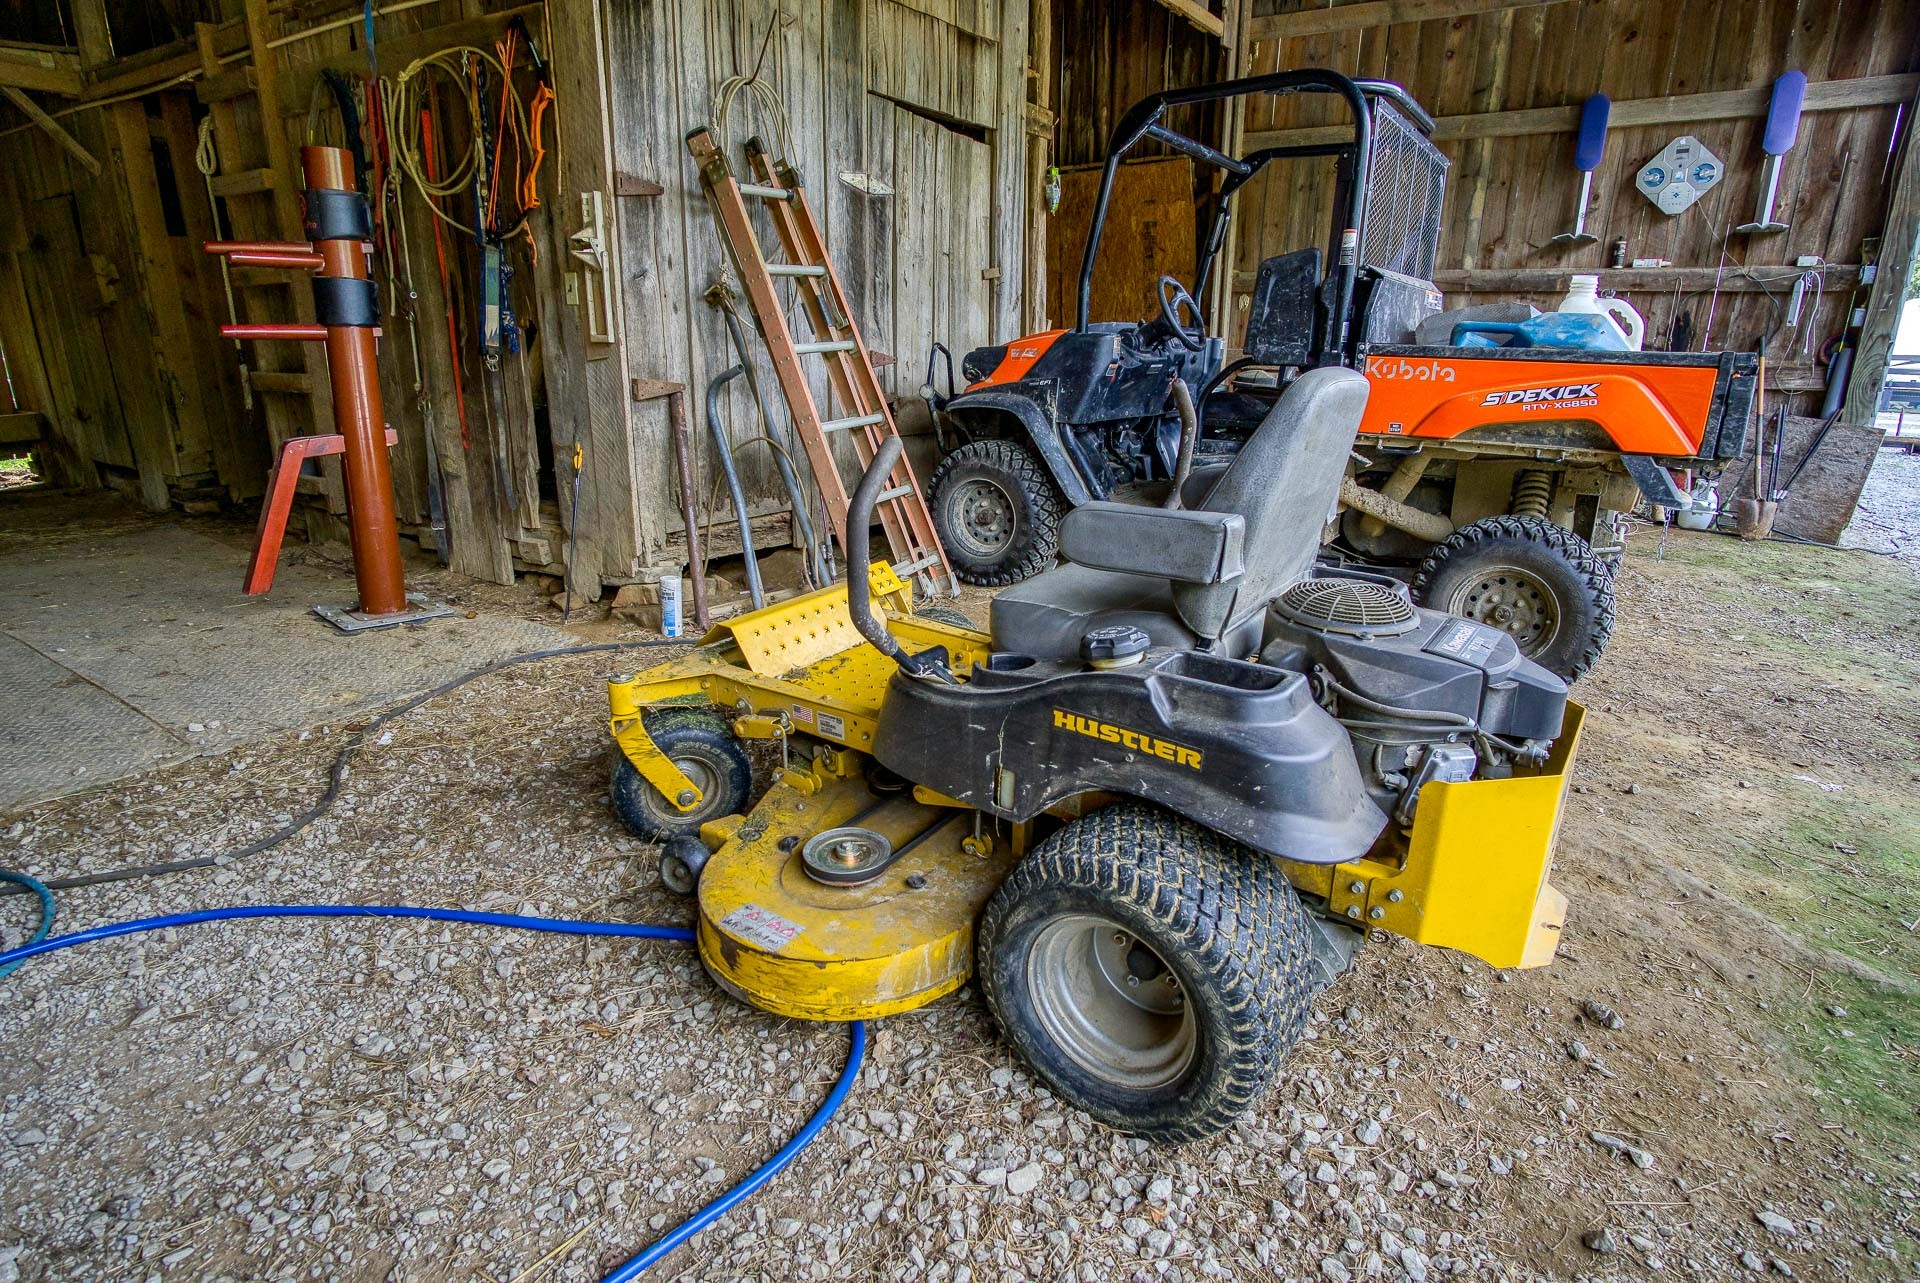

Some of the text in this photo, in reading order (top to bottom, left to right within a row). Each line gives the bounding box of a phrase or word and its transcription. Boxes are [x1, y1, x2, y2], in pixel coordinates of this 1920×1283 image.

[1365, 358, 1456, 382] Kubota
[1480, 382, 1601, 407] SIDEKICK
[1522, 398, 1598, 412] RTV-XG850
[1053, 709, 1202, 771] HUSTLER
